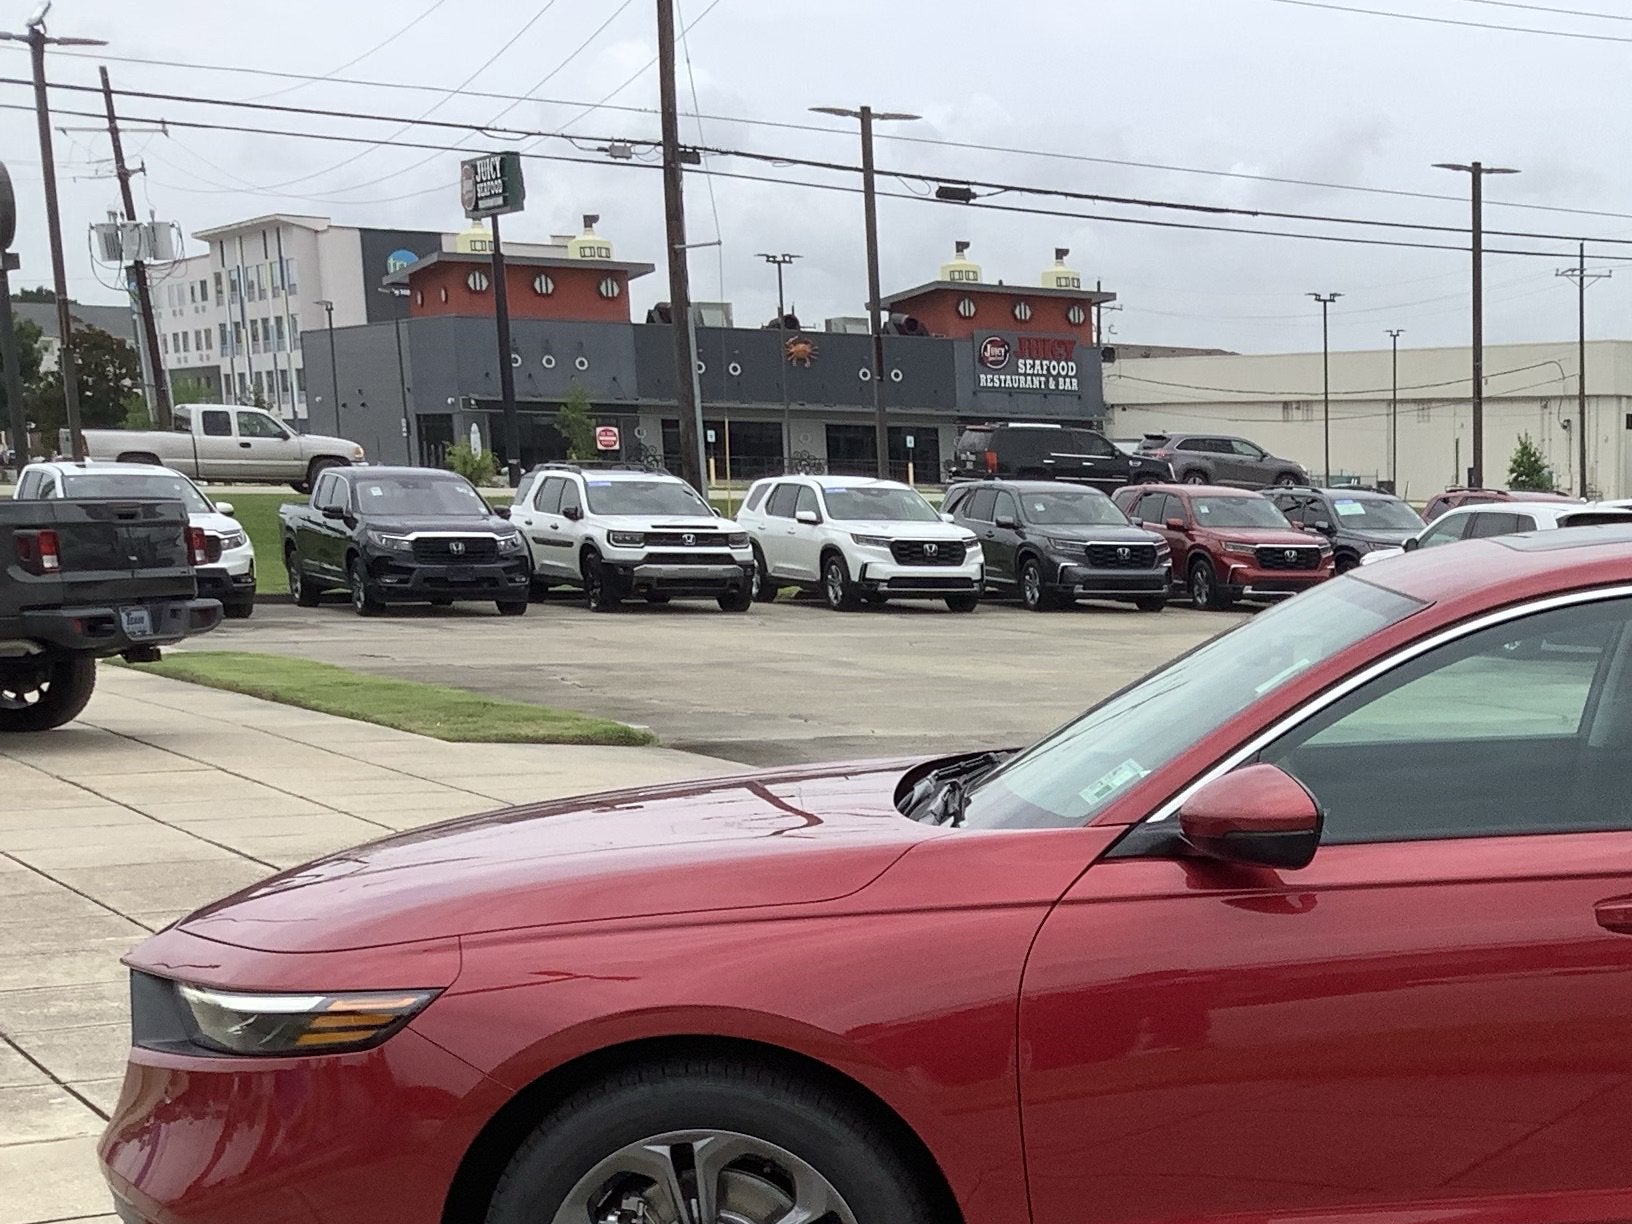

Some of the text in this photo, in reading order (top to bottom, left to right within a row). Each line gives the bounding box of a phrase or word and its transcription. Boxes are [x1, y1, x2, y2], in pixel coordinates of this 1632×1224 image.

[476, 156, 501, 182] JUICY
[1013, 337, 1076, 360] JUICY
[1018, 359, 1076, 376] SEAFOOD
[979, 374, 1078, 391] RESTAURANT & BAR
